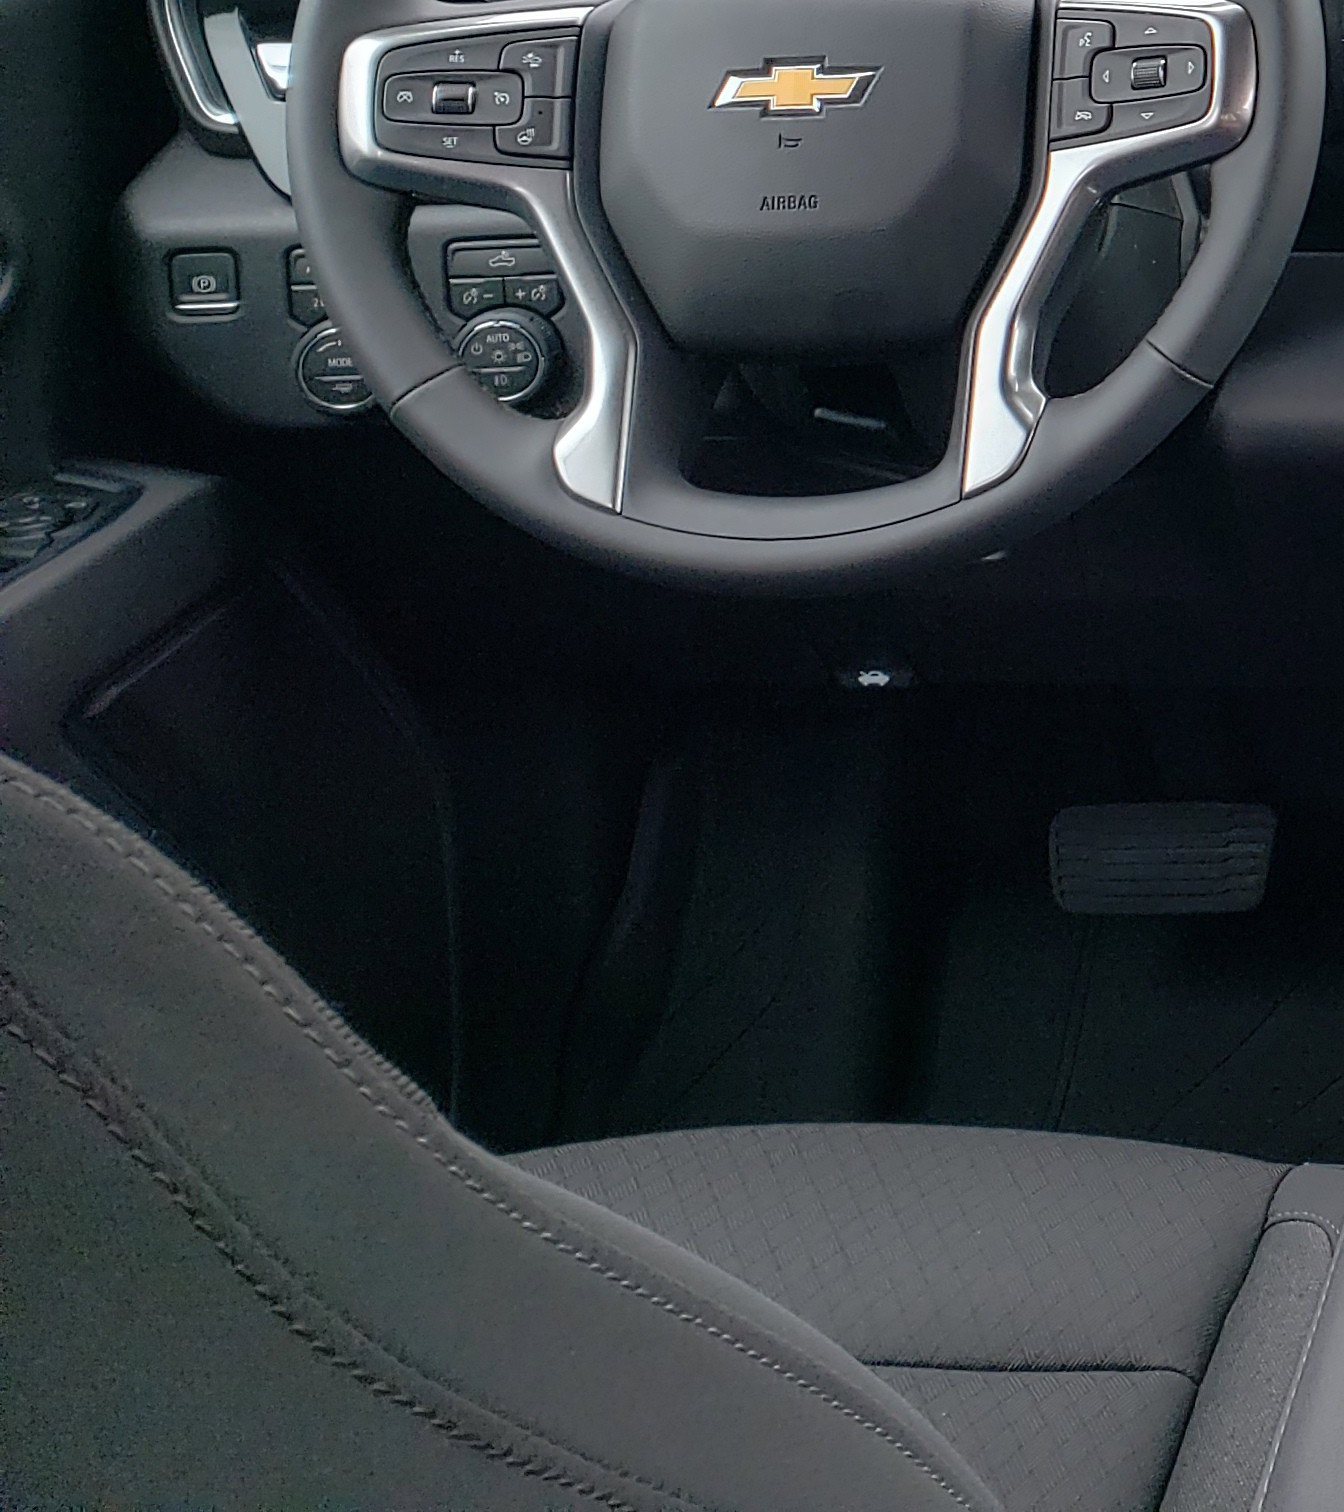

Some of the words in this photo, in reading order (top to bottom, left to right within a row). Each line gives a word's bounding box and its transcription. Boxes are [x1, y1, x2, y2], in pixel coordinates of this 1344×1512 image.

[449, 54, 464, 63] RES
[442, 137, 458, 146] SET
[759, 195, 819, 211] AIRBAG
[487, 333, 510, 343] AUTO
